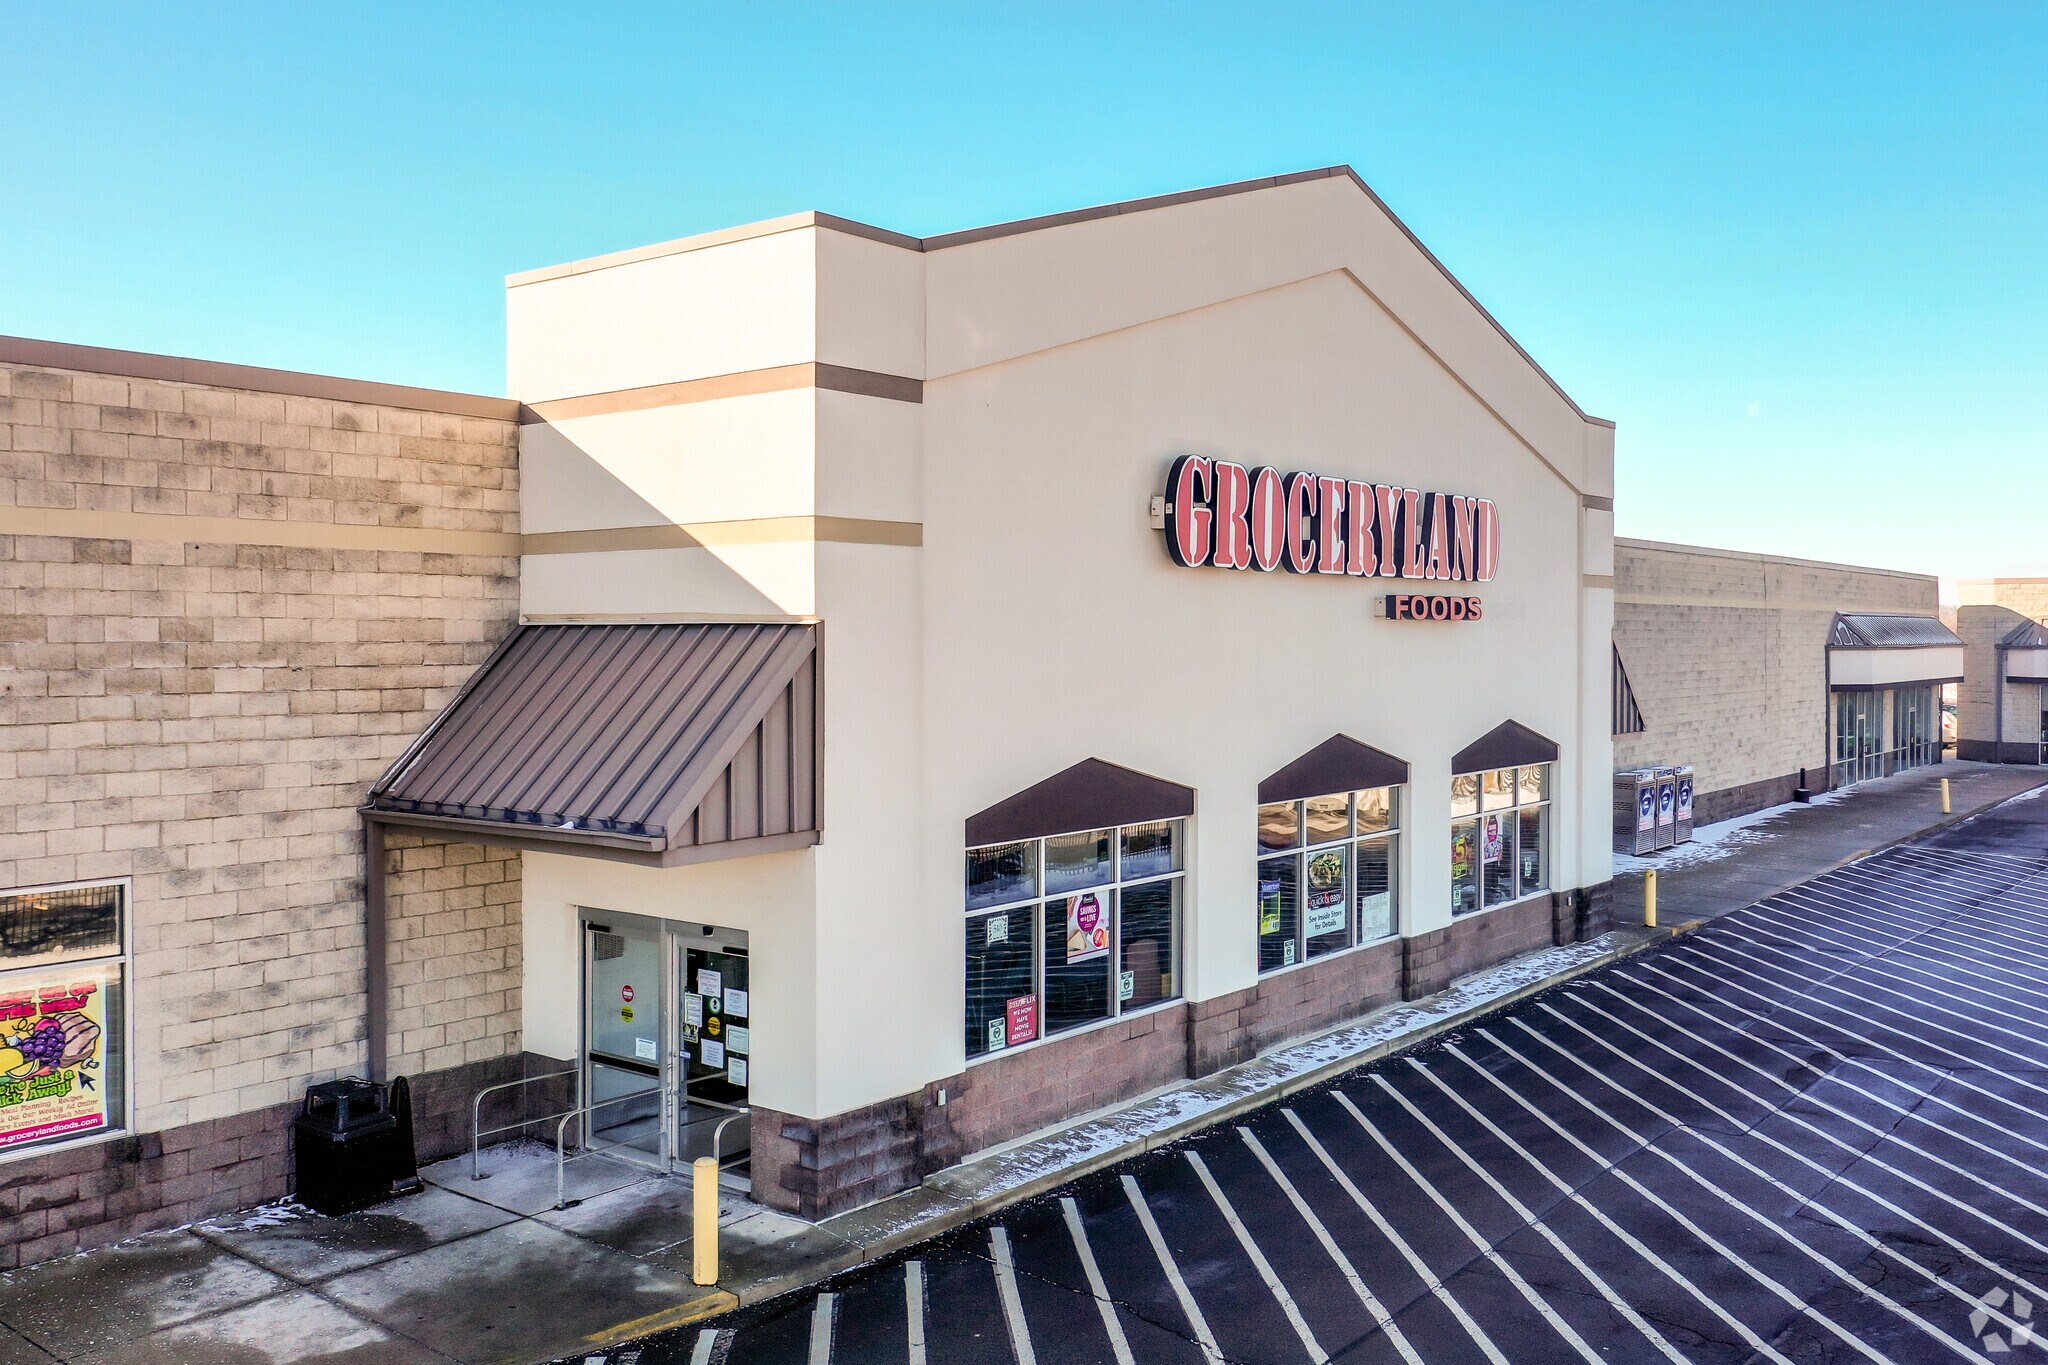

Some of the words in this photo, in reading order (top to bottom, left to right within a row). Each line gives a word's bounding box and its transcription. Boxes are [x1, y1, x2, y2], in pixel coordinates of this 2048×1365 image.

[1166, 453, 1500, 582] GROCERYLAND
[1394, 594, 1483, 621] FOODS
[1308, 915, 1318, 924] See
[1318, 911, 1331, 921] Inside
[1331, 909, 1343, 918] Store
[1314, 922, 1322, 931] for
[1322, 919, 1337, 929] Details
[30, 1071, 61, 1087] Just
[64, 1069, 75, 1081] a
[27, 1081, 72, 1100] Away!
[1, 1107, 18, 1115] Meal
[21, 1100, 52, 1111] Planning
[58, 1094, 84, 1105] Recipes
[22, 1111, 36, 1119] Our
[38, 1106, 64, 1116] Weekly
[66, 1102, 76, 1110] Ad
[77, 1099, 99, 1108] Online
[13, 1119, 36, 1128] Events
[38, 1114, 52, 1123] and
[54, 1111, 72, 1121] Much
[74, 1106, 95, 1117] More!
